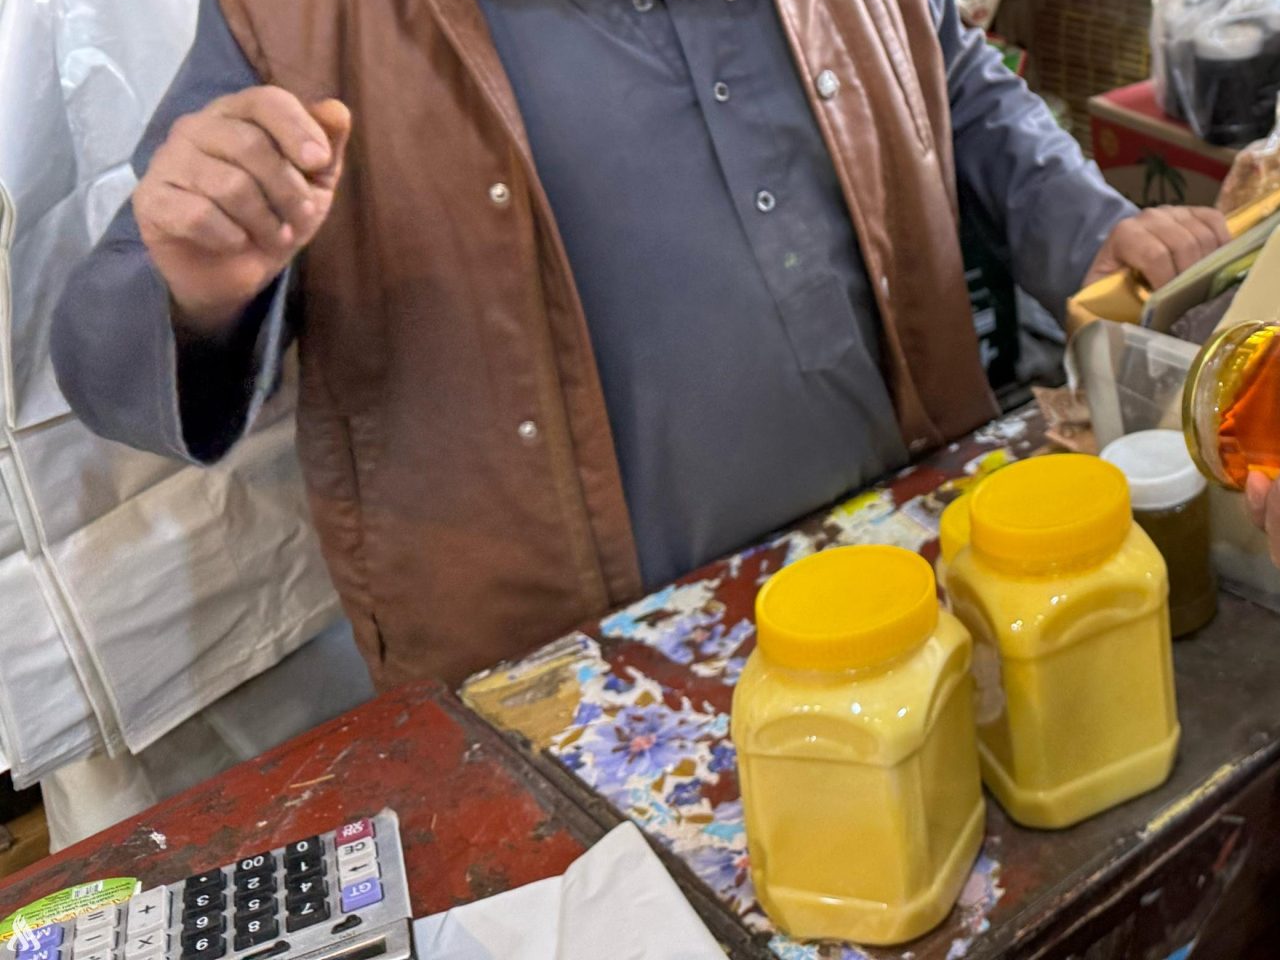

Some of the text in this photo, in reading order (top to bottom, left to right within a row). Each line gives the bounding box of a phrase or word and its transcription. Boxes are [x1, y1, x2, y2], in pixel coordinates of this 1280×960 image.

[296, 841, 309, 852] 0
[343, 841, 366, 855] CE
[242, 855, 265, 870] 00
[300, 862, 309, 871] 1
[247, 877, 260, 890] 2
[299, 882, 313, 893] 4
[349, 882, 372, 897] GT
[196, 894, 210, 907] 3
[247, 899, 260, 911] 5
[300, 902, 314, 915] 7
[196, 916, 209, 929] 6
[247, 920, 261, 933] 8
[195, 938, 209, 951] 9
